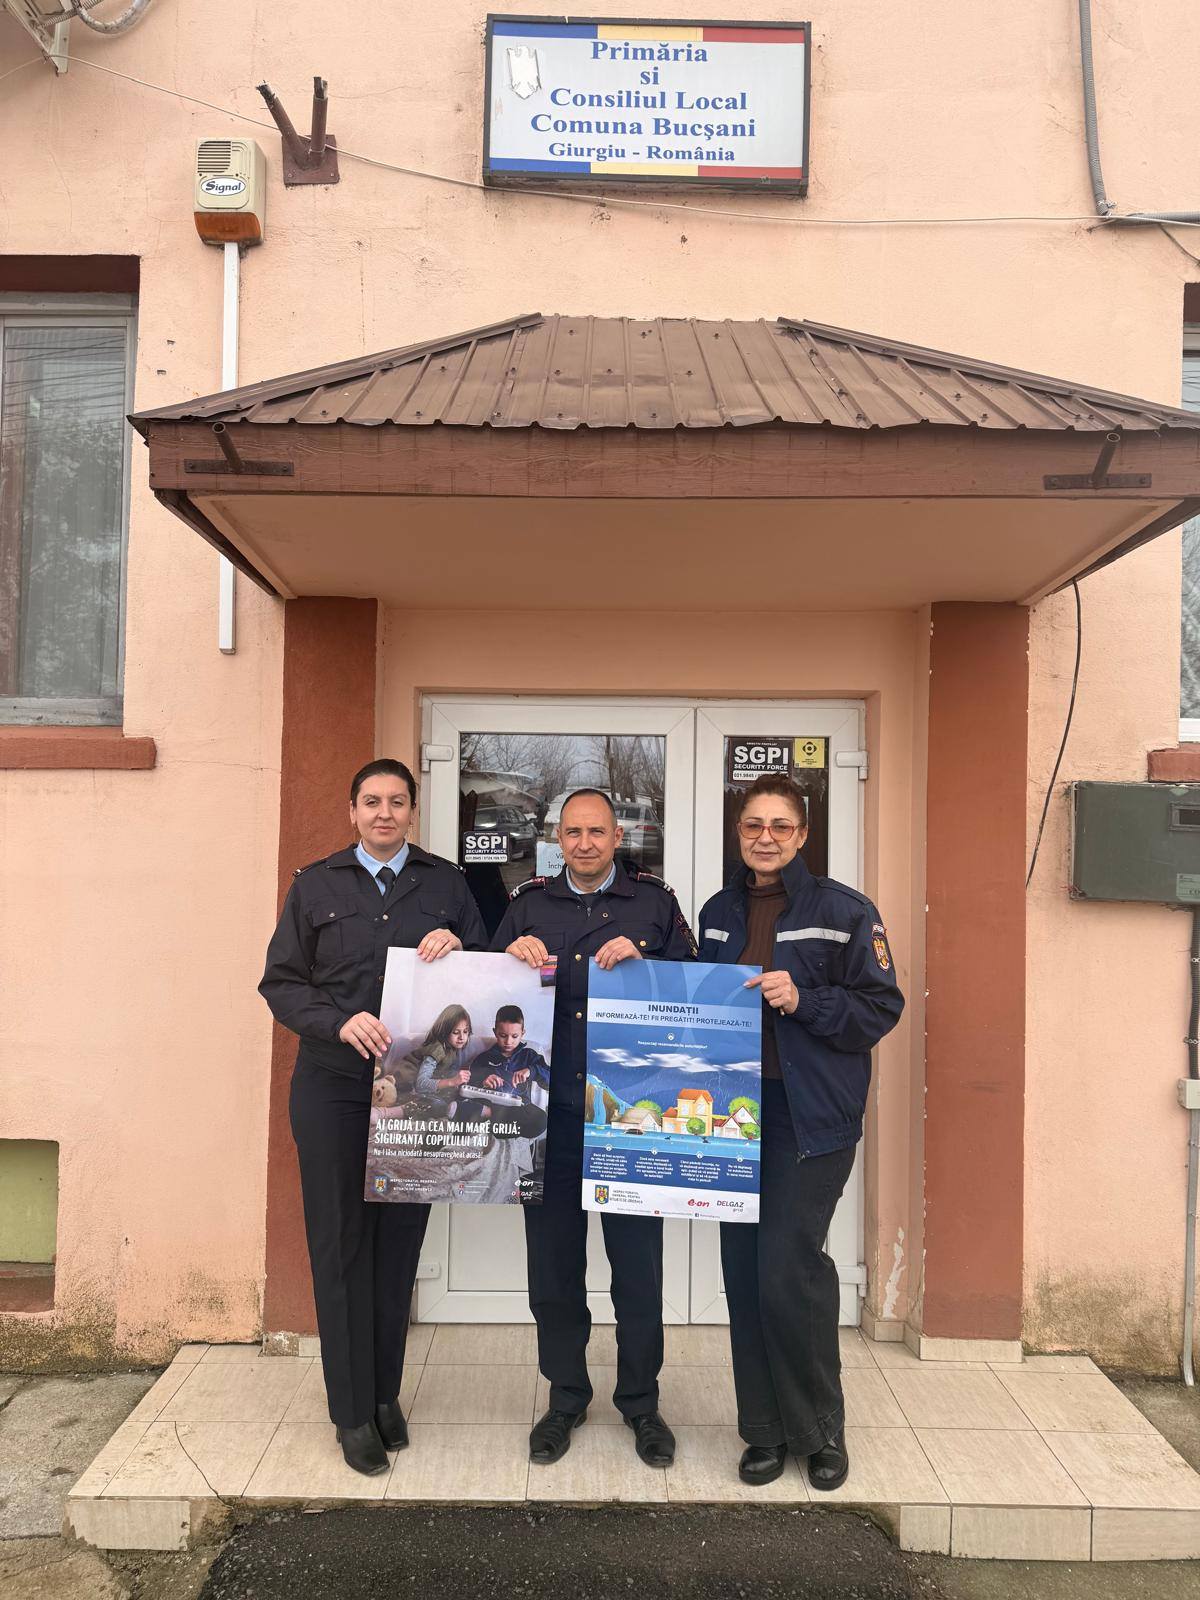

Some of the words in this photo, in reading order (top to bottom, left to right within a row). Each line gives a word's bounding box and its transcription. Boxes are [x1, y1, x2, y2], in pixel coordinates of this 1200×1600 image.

[590, 41, 708, 62] Primăria
[640, 66, 659, 85] si
[550, 88, 666, 109] Consiliul
[675, 91, 747, 110] Local
[530, 114, 642, 135] Comuna
[548, 142, 626, 162] Giurgiu
[647, 146, 735, 162] România
[205, 181, 241, 194] Signal
[734, 746, 789, 764] SGPI
[465, 835, 507, 849] SGPI
[595, 1011, 650, 1021] INFORMEAZĂ-TE!
[696, 1016, 752, 1027] PROTEJEAZĂ-TE!
[648, 1004, 699, 1016] INUNDAȚII
[375, 1118, 385, 1130] AI
[387, 1116, 413, 1132] GRIJĂ
[415, 1120, 425, 1132] LA
[428, 1120, 444, 1132] CEA
[446, 1121, 464, 1133] MAI
[492, 1120, 521, 1135] GRIJĂ:
[374, 1133, 424, 1148] SIGURANȚA
[426, 1134, 471, 1147] COPILULUI
[716, 1200, 745, 1208] DELGAZ
